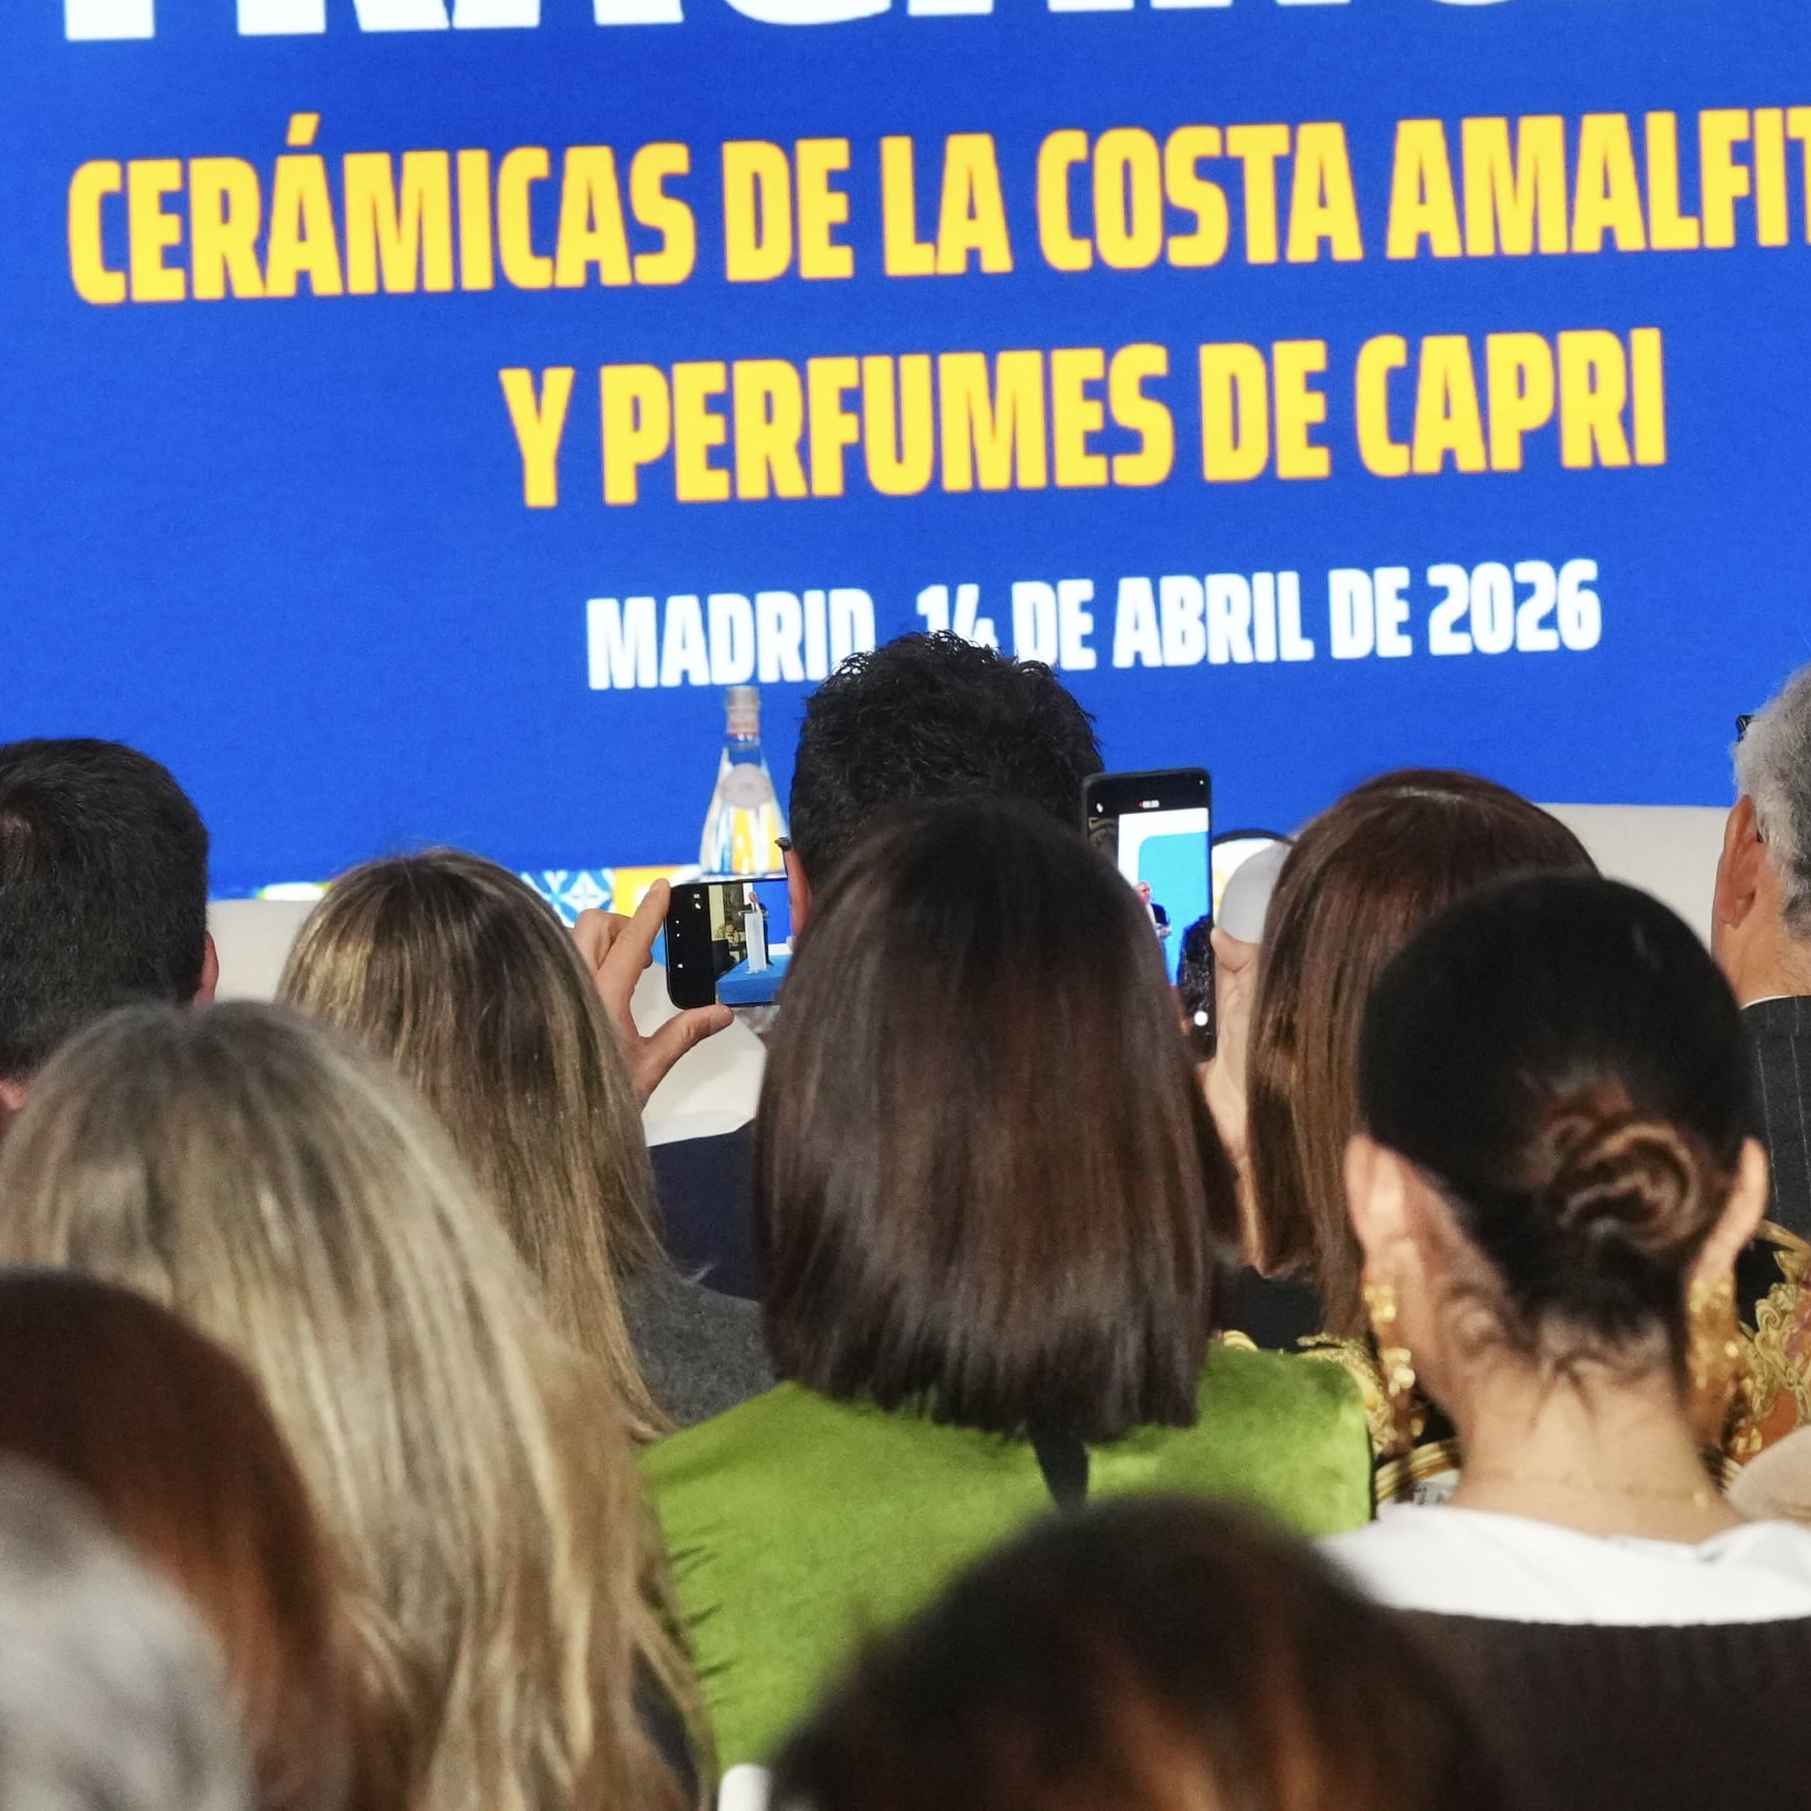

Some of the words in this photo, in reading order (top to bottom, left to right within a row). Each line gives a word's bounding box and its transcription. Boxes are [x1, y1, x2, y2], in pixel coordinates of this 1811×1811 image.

[67, 112, 697, 306] CERÁMICAS
[721, 137, 855, 284] DE
[879, 133, 1014, 279] LA
[1034, 121, 1365, 274] COSTA
[498, 366, 576, 509] Y
[599, 342, 1176, 507] PERFUMES
[1198, 339, 1332, 484] DE
[1353, 327, 1667, 478] CAPRI
[1011, 579, 1097, 672] DE
[1112, 570, 1315, 669] ABRIL
[1328, 566, 1413, 660] DE
[1427, 558, 1603, 656] 2026
